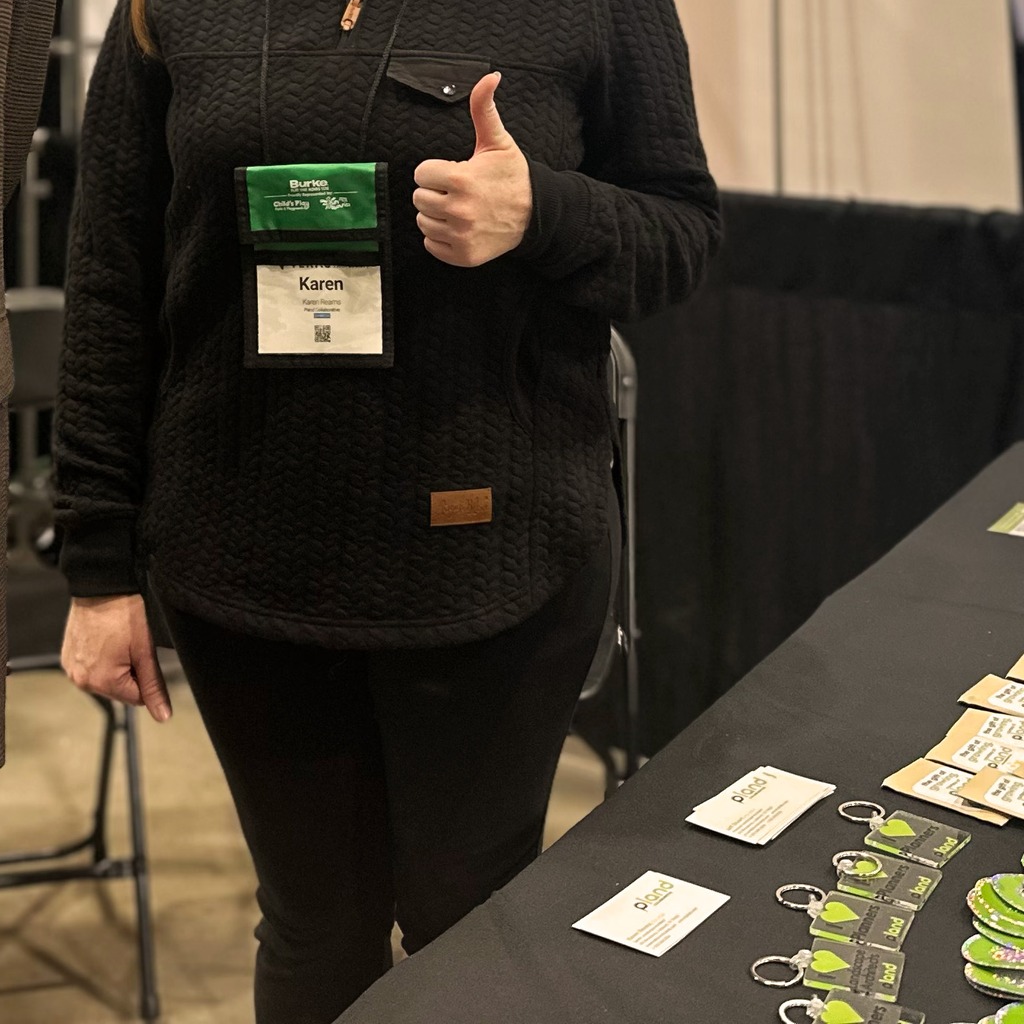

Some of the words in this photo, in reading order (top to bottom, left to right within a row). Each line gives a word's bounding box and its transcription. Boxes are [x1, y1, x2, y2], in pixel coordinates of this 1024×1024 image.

[289, 180, 328, 188] Burke
[300, 277, 343, 290] Karen
[731, 777, 767, 804] pland
[933, 836, 958, 857] pland
[634, 880, 674, 912] pland
[910, 876, 932, 899] pland
[883, 916, 904, 941] pland
[879, 963, 897, 989] pland
